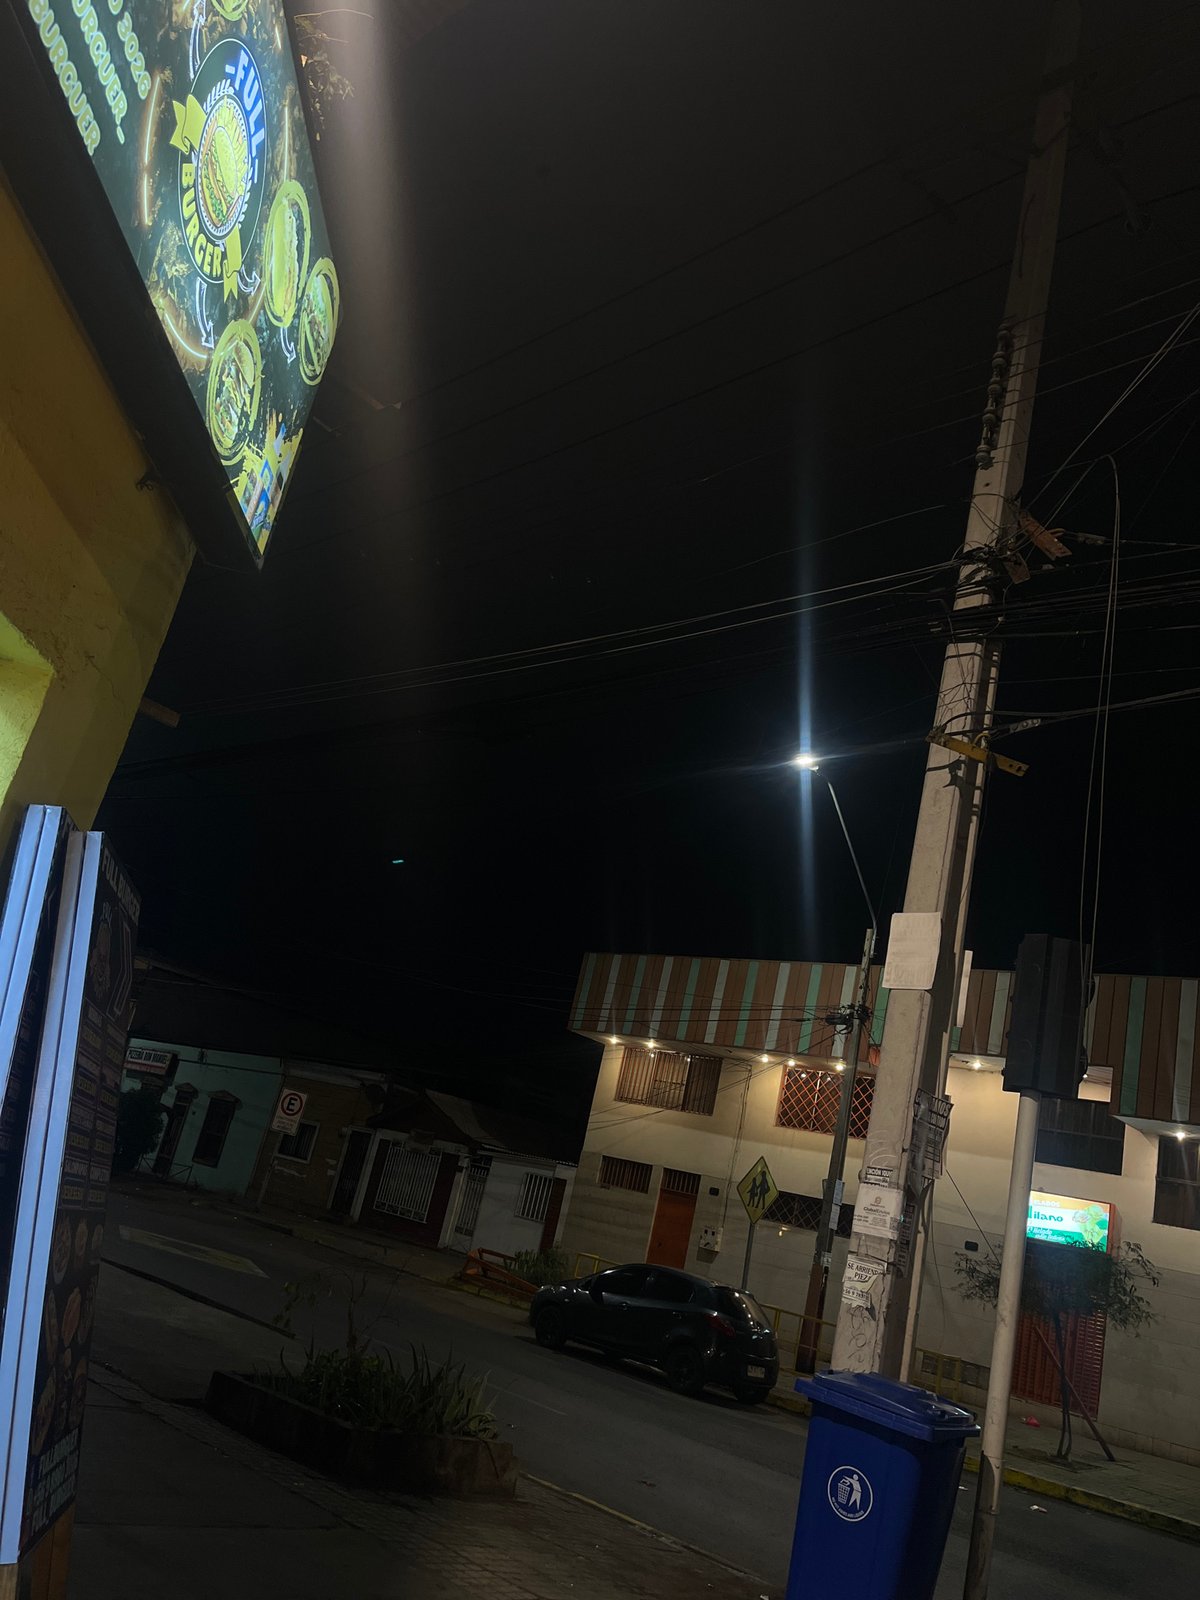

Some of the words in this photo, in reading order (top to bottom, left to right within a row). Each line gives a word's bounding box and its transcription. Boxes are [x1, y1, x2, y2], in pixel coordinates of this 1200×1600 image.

[116, 11, 152, 100] 3026
[182, 162, 223, 278] BURGER
[102, 846, 119, 894] FULL
[286, 1097, 298, 1112] E
[1028, 1205, 1064, 1222] ilano
[847, 1261, 855, 1271] SE
[854, 1271, 871, 1281] PIEZ
